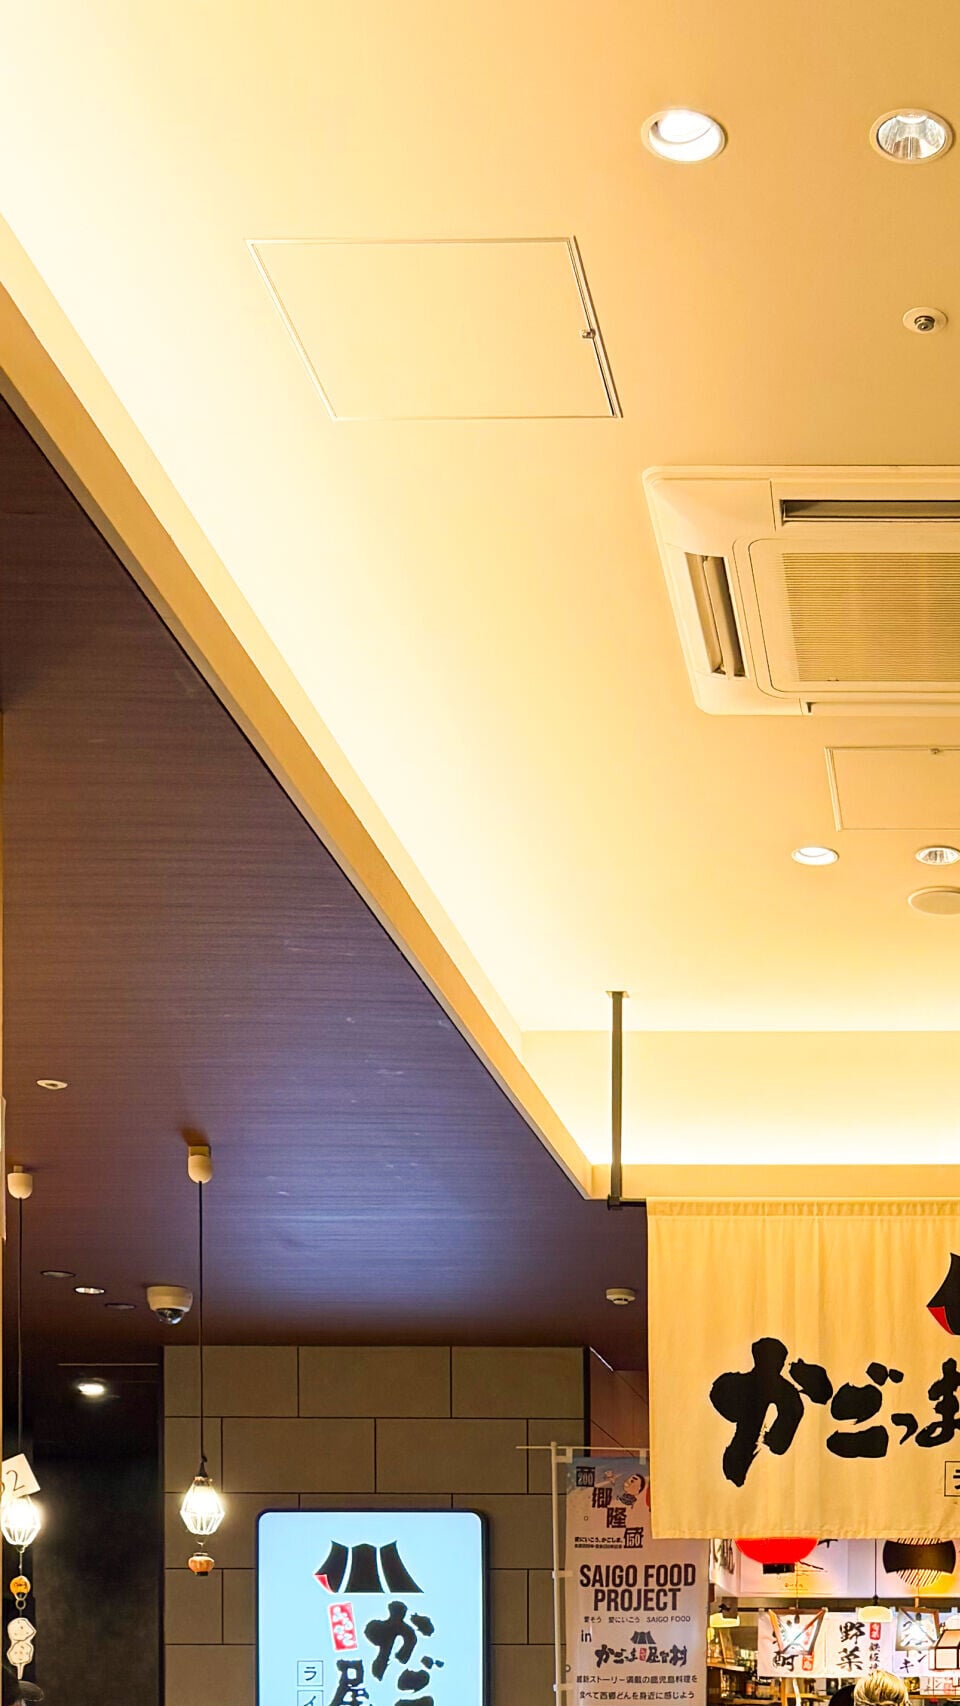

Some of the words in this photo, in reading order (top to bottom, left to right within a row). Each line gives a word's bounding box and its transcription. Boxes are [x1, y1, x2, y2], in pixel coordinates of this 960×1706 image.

[580, 1564, 638, 1587] SAIGO
[644, 1563, 696, 1588] FOOD
[593, 1588, 681, 1612] PROJECT
[581, 1629, 592, 1643] in
[837, 1620, 866, 1672] 野菜
